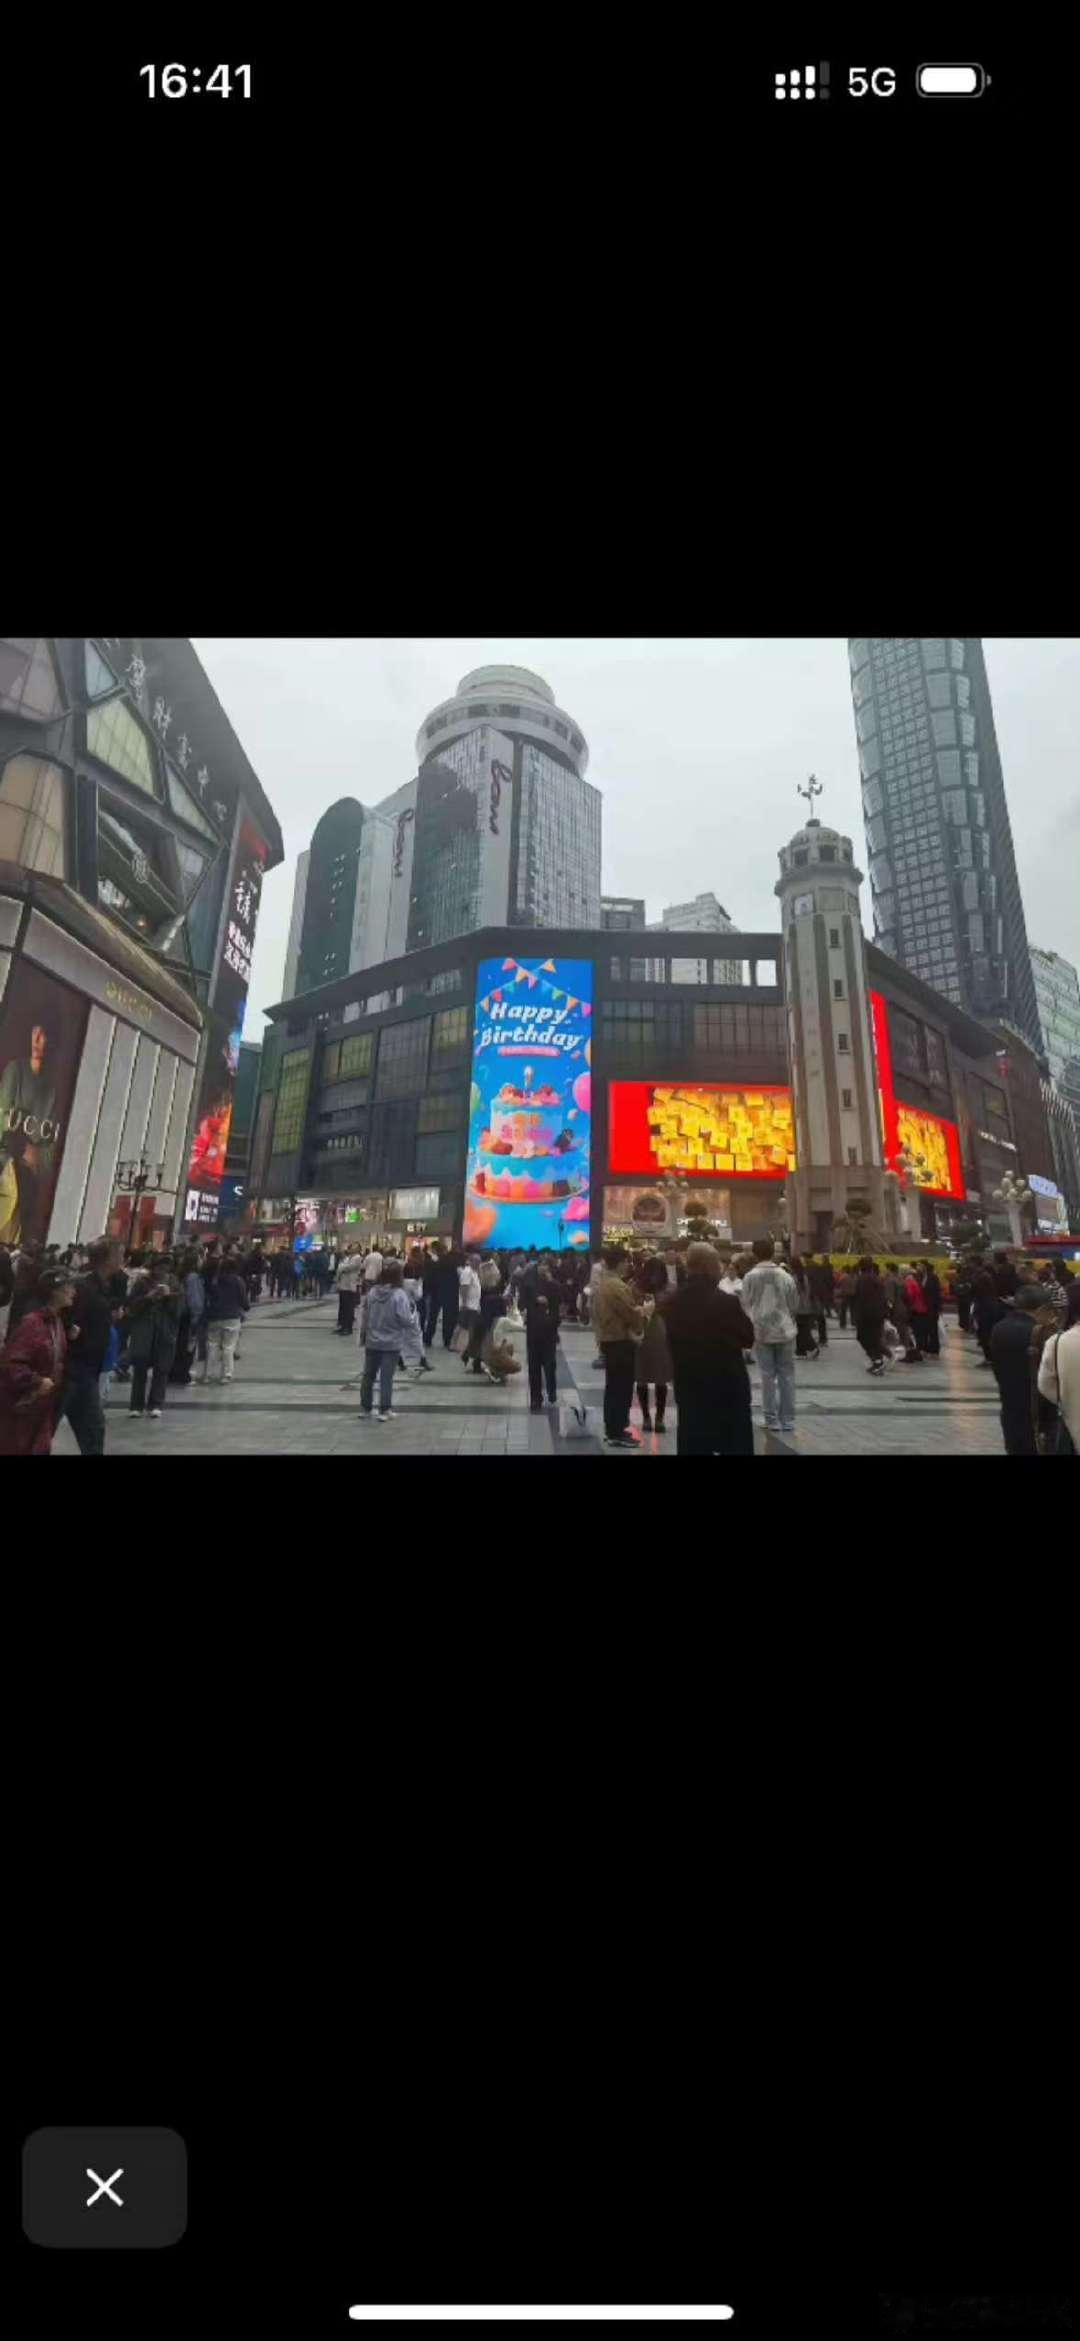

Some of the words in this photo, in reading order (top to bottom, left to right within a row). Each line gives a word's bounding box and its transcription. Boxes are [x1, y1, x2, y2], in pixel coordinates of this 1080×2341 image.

[490, 1002, 569, 1025] Happy
[480, 1024, 584, 1051] Birthday
[0, 1105, 61, 1143] UCCI
